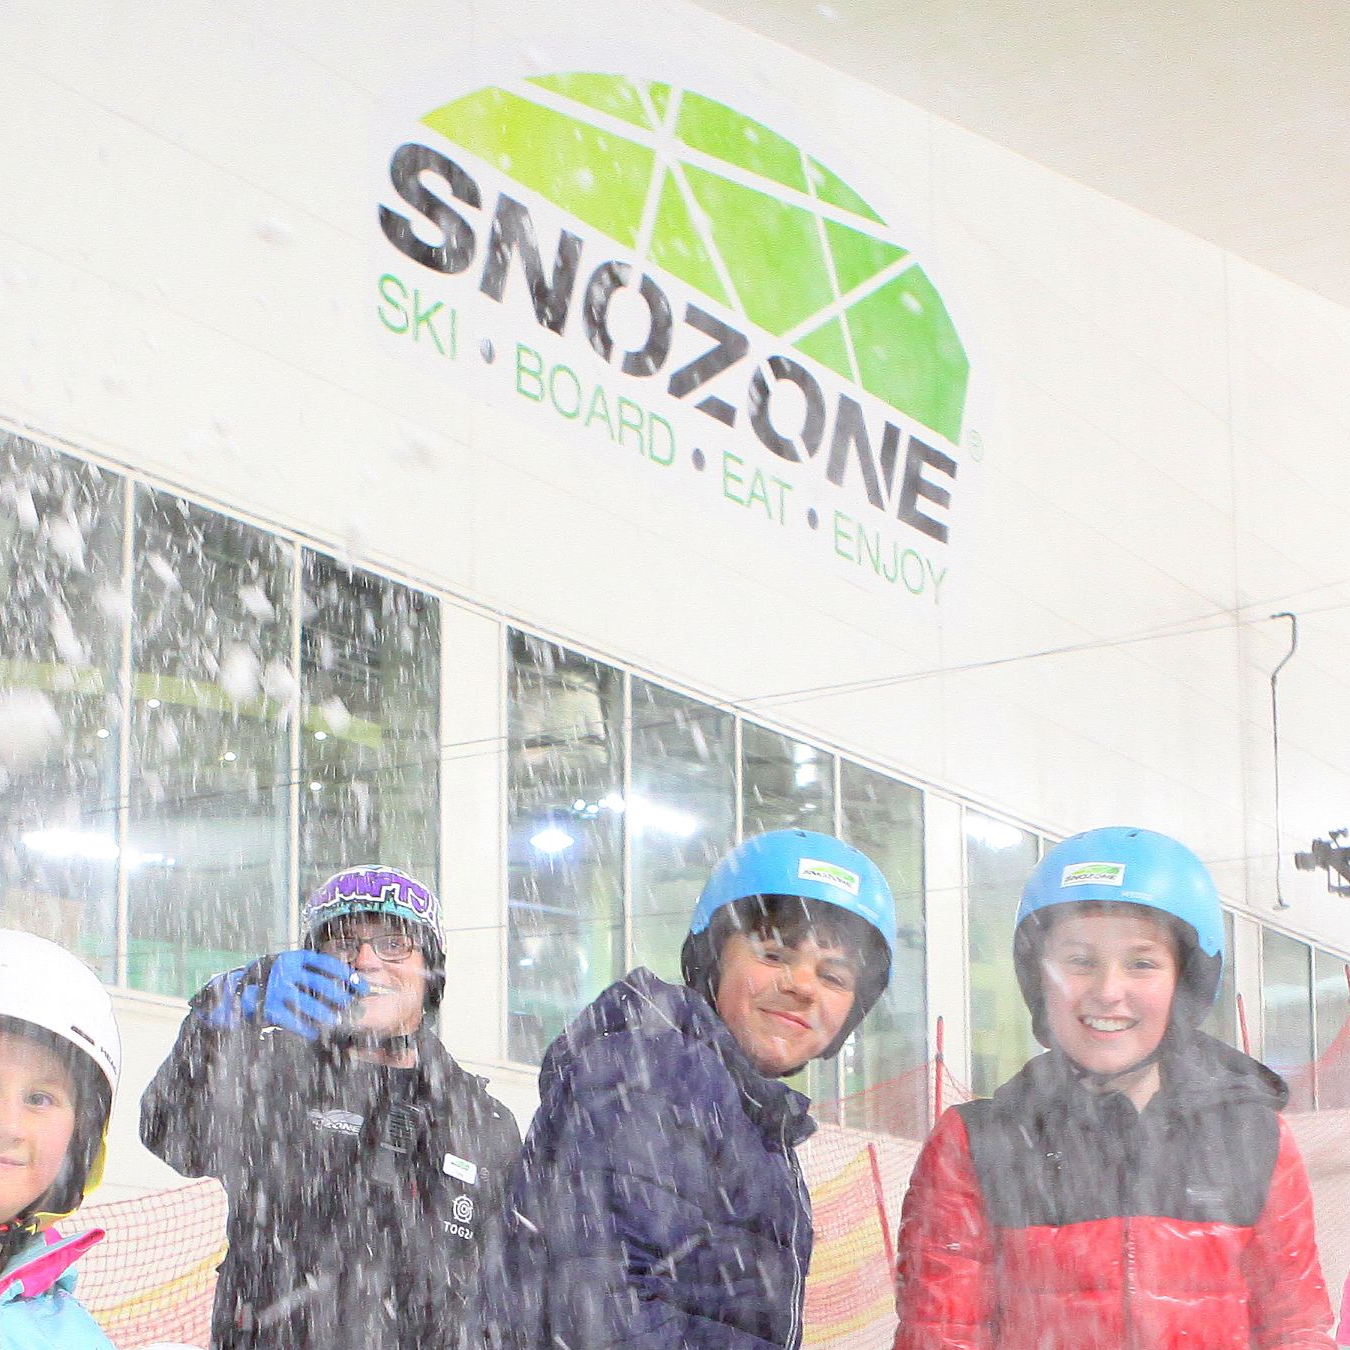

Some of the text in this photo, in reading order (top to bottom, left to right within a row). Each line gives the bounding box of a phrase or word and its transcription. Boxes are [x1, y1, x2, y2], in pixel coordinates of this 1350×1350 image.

[378, 142, 958, 544] SNOZONE
[378, 273, 948, 604] SKI BOARD EAT ENJOY
